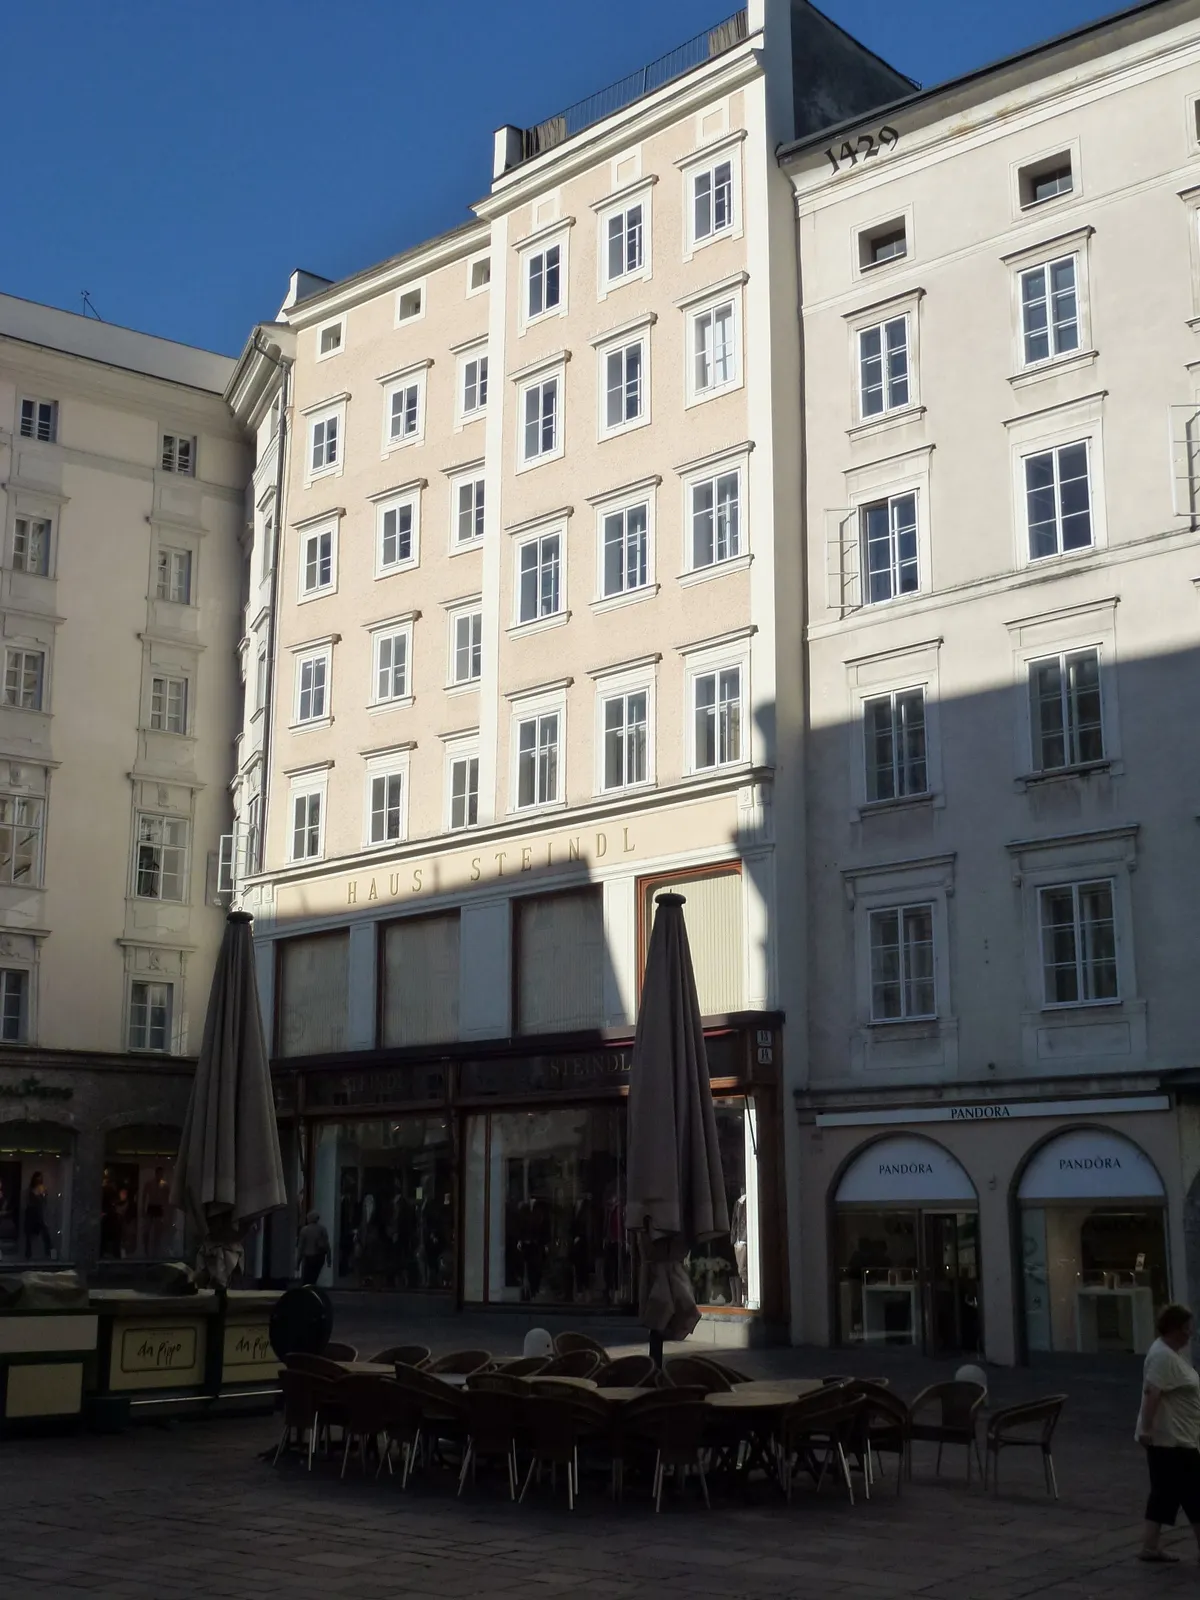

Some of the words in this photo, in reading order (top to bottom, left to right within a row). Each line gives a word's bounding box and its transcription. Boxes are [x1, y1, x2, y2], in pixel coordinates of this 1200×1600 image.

[824, 126, 899, 176] 1429
[347, 869, 423, 904] HAUS
[470, 827, 636, 881] STEINDL
[550, 1053, 632, 1077] STEINDL
[951, 1106, 1010, 1119] PANDORA
[879, 1163, 933, 1175] PANDORA
[1059, 1157, 1121, 1170] PANDORA
